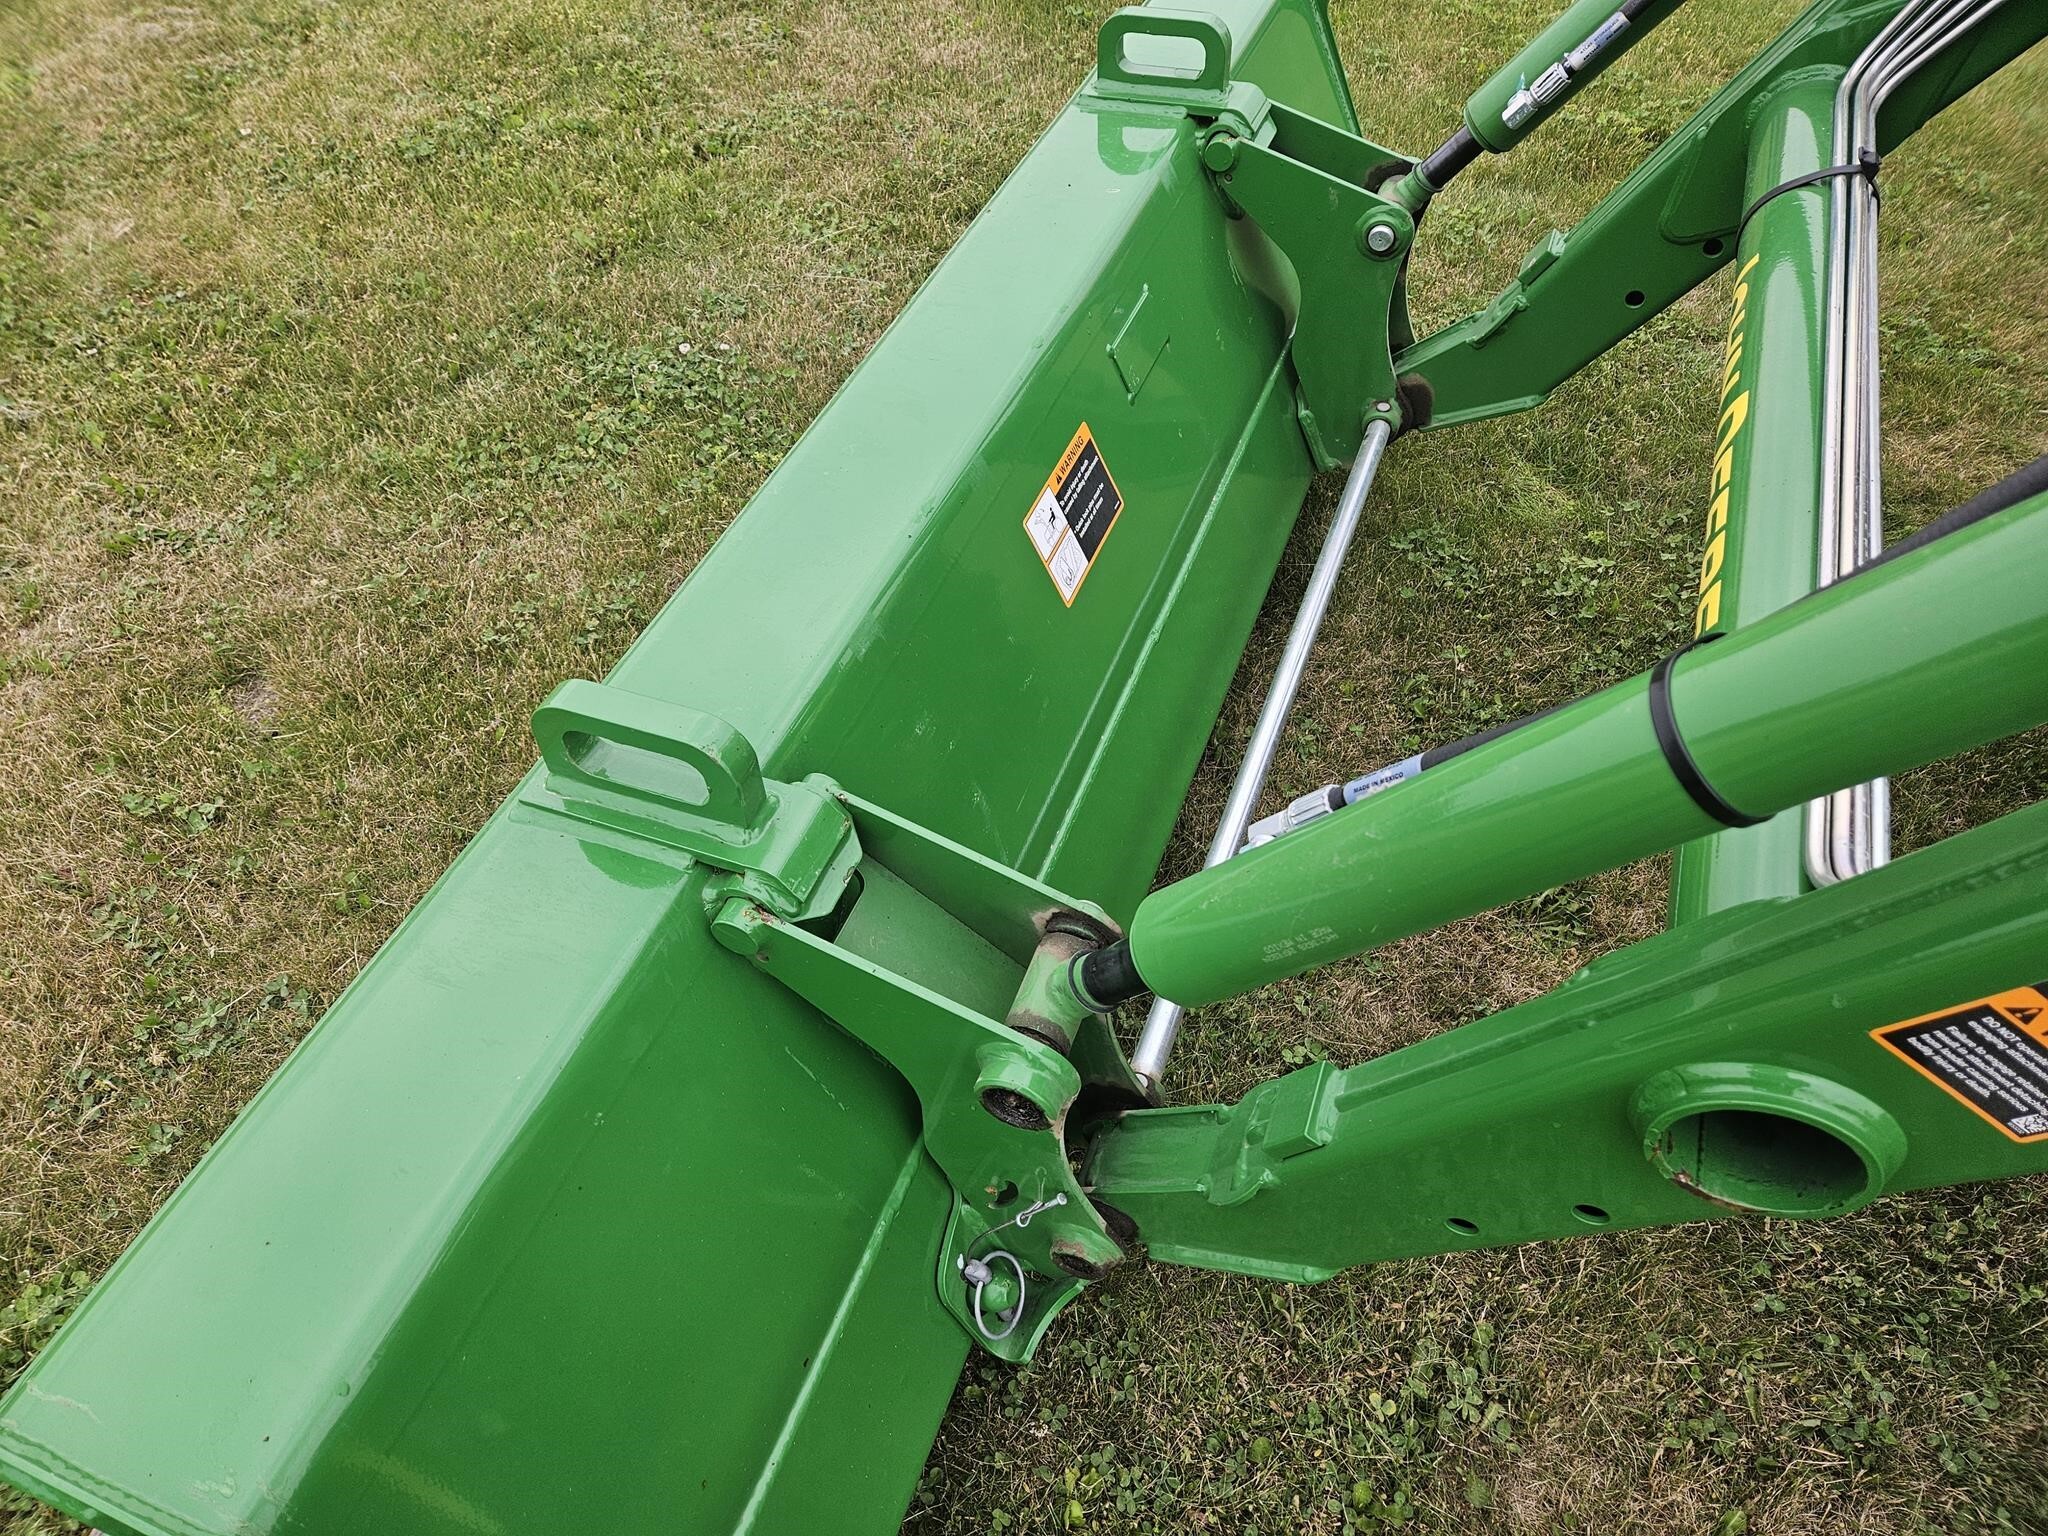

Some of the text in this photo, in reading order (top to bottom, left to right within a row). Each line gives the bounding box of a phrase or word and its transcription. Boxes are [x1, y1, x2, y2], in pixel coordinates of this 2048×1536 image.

[1060, 434, 1084, 477] WARNING
[1353, 784, 1370, 793] MADE
[1380, 771, 1404, 784] MEXICO
[1946, 1026, 1976, 1047] Failure
[1984, 1054, 2016, 1076] engage
[1968, 1021, 2008, 1049] engaging
[1981, 1016, 2000, 1028] DO
[1996, 1027, 2021, 1041] NOT
[1907, 1037, 1935, 1055] bodily
[1932, 1055, 1958, 1072] injury
[1964, 1079, 1990, 1098] death.
[1920, 1034, 2029, 1112] from loader causing serious
[1933, 1030, 1961, 1048] result
[1965, 1054, 2014, 1088] attachment
